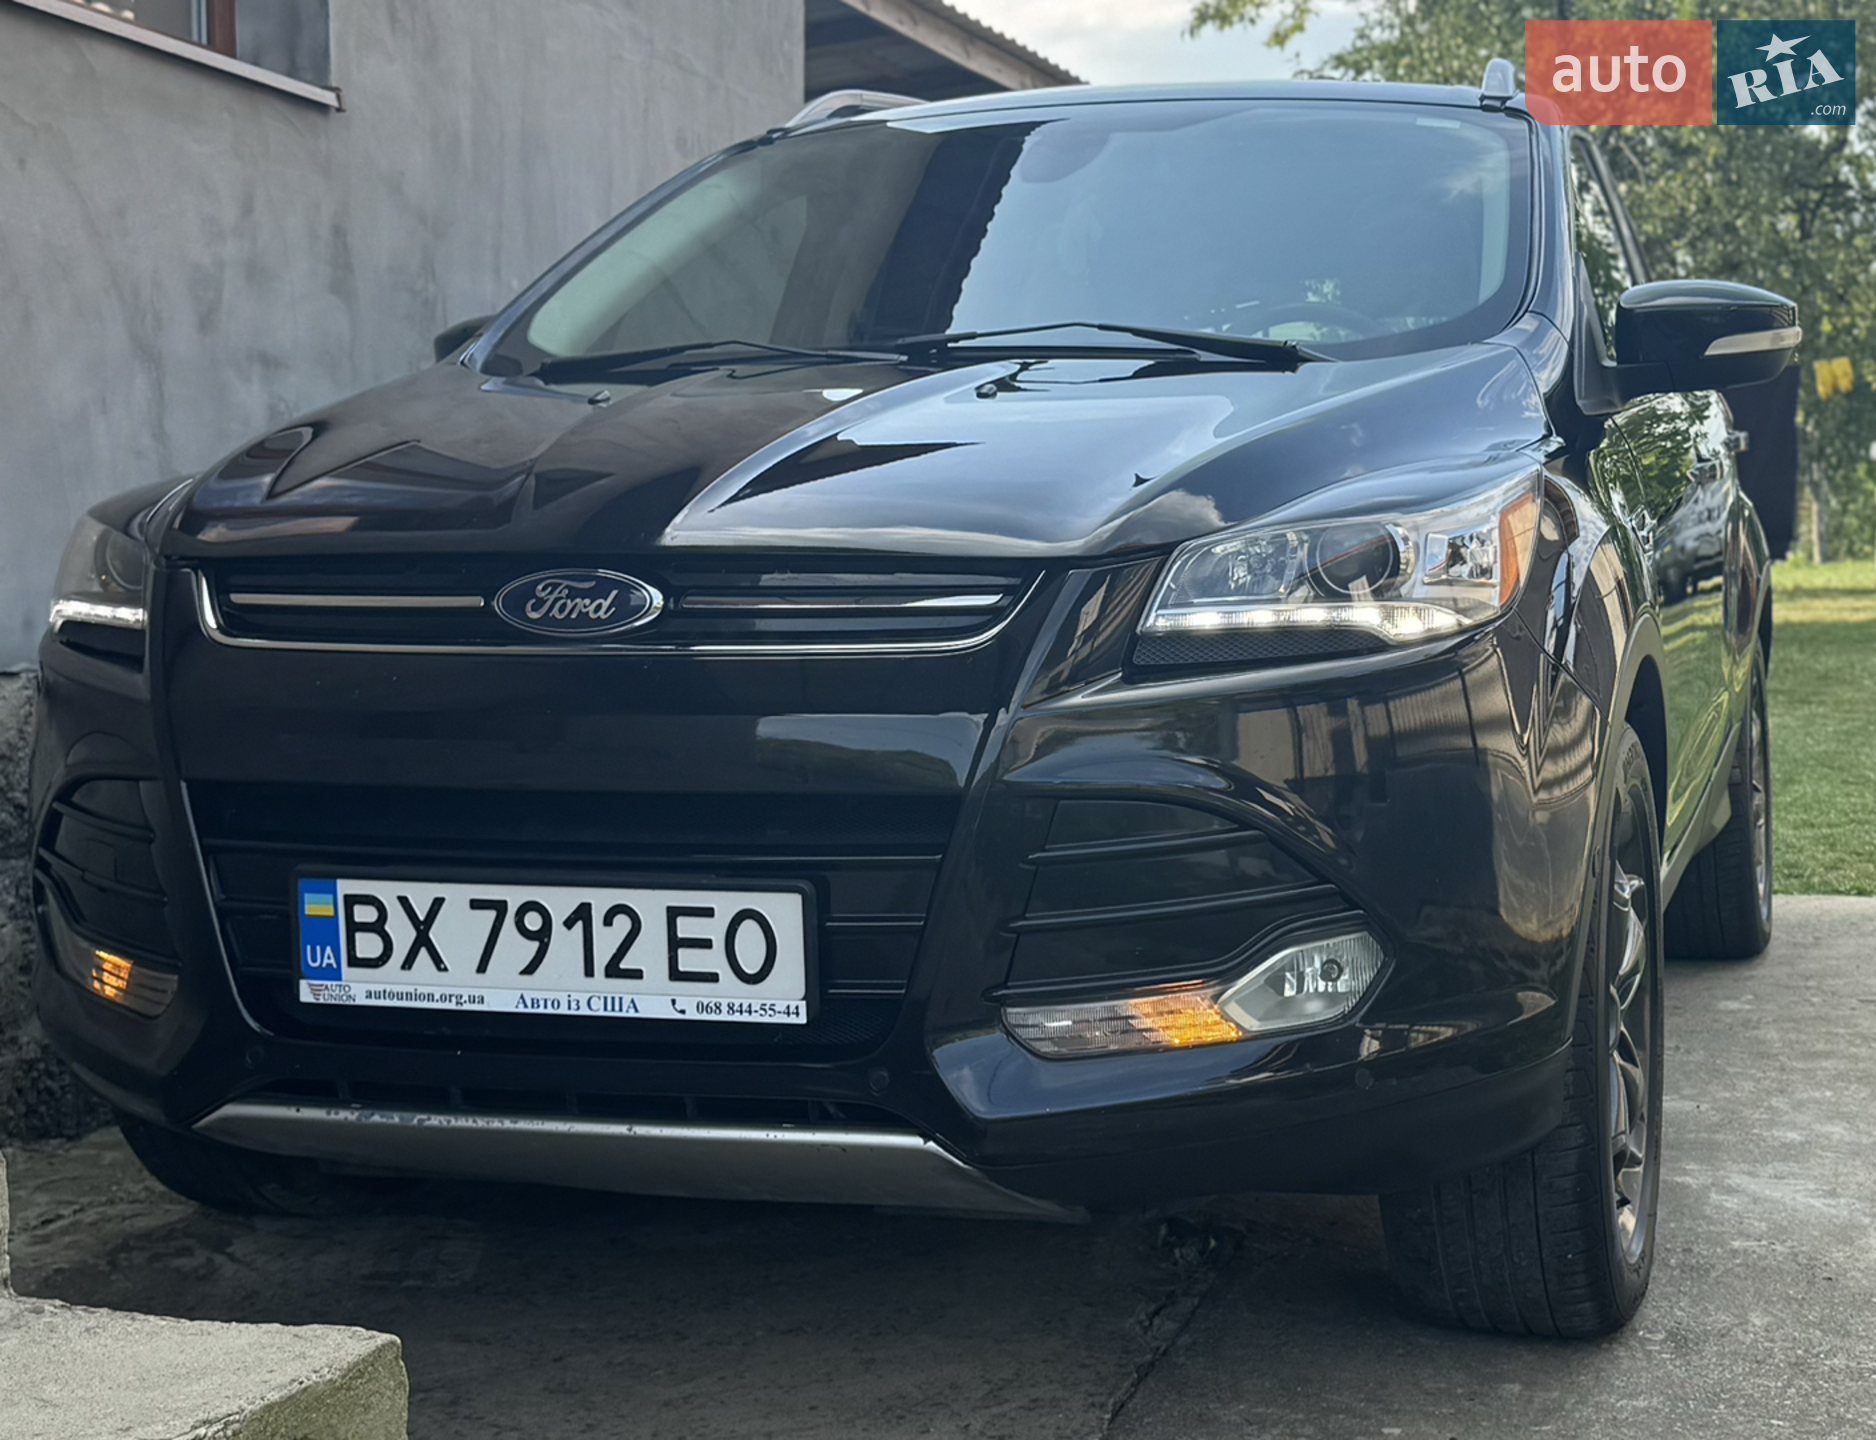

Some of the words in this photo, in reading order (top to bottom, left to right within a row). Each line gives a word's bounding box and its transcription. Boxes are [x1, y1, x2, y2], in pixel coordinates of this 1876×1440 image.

[525, 578, 619, 620] Ford
[468, 898, 645, 980] 7912
[306, 944, 338, 969] UA
[322, 993, 357, 1003] UNION
[323, 983, 352, 994] AUTO
[364, 988, 486, 1007] autounion.org.ua
[514, 993, 561, 1010] Авто
[567, 995, 581, 1012] із
[586, 994, 640, 1014] США
[695, 1001, 722, 1016] 068
[726, 1002, 801, 1019] 844-55-44
